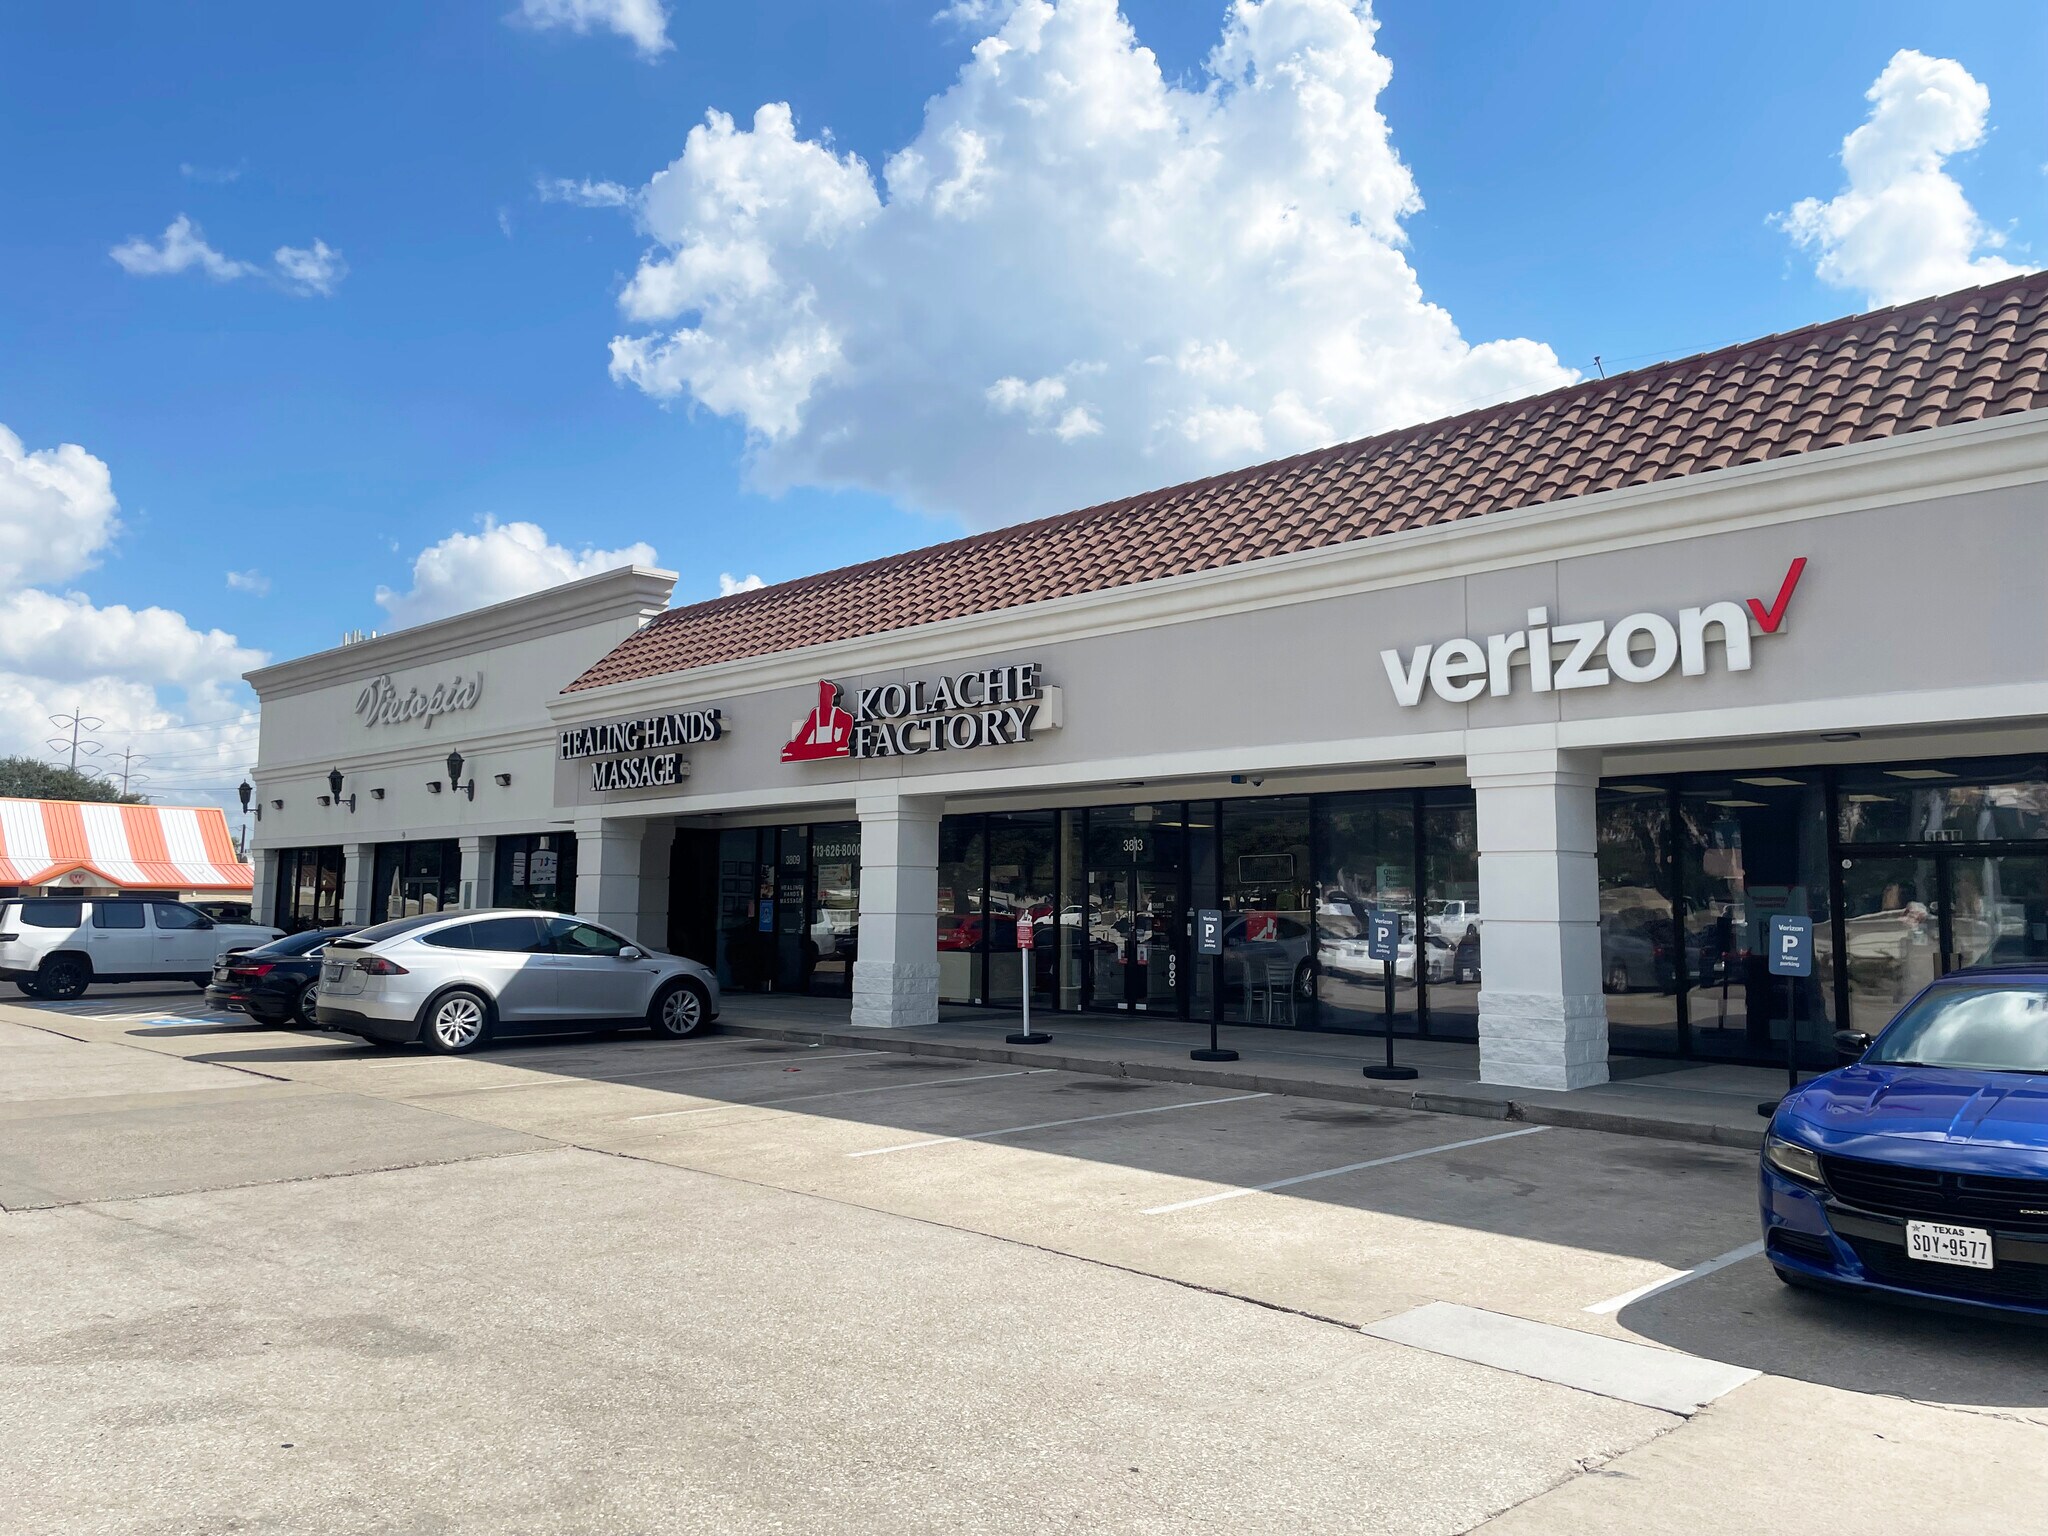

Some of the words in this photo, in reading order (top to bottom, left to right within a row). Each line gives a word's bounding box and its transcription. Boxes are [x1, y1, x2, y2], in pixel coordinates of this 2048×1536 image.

[1379, 600, 1752, 707] verizon
[354, 673, 483, 729] Vietopia
[855, 662, 1041, 723] KOLACHE
[559, 720, 643, 760] HEALING
[643, 708, 720, 749] HANDS
[854, 704, 1040, 759] FACTORY
[590, 752, 682, 791] MASSAGE
[1123, 839, 1143, 851] 3813
[1205, 923, 1215, 938] P
[1377, 927, 1389, 942] P
[1782, 935, 1799, 953] P
[1932, 1225, 1965, 1237] TEXAS
